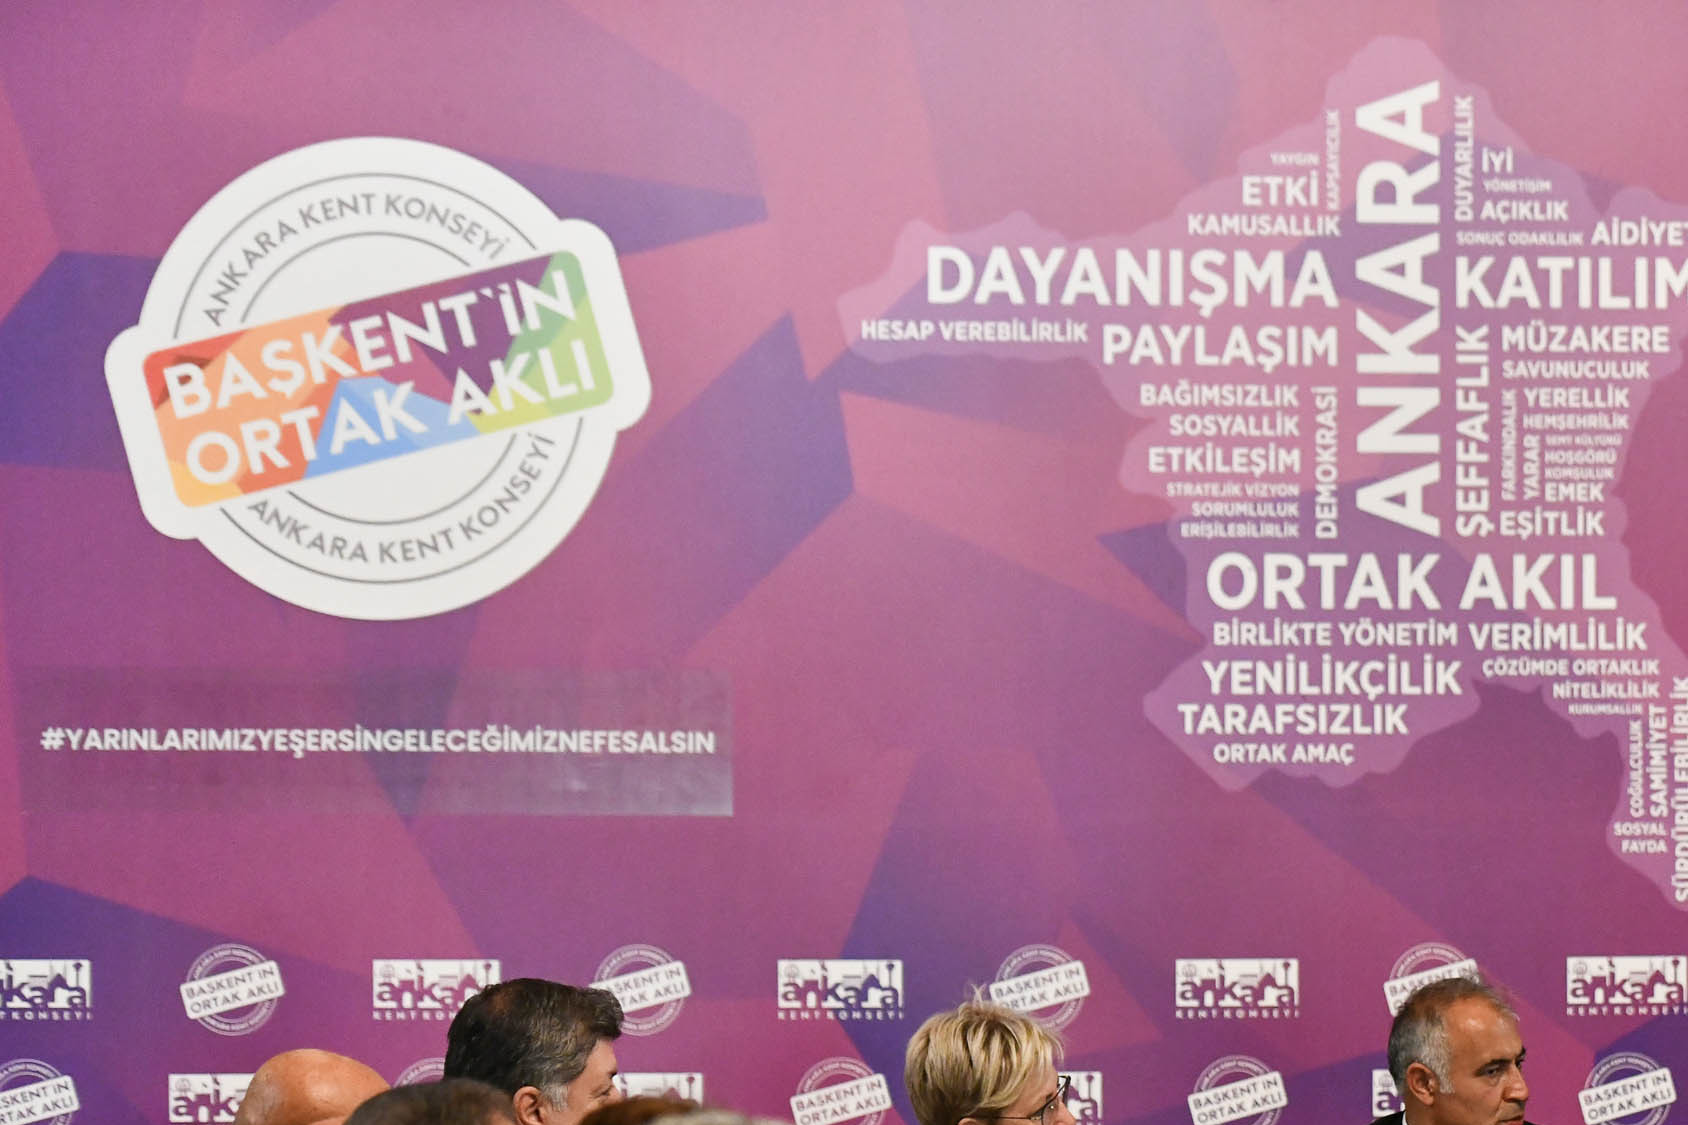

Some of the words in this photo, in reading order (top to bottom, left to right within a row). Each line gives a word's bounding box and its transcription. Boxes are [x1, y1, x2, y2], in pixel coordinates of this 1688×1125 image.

[1455, 96, 1474, 221] DUYARLILIK
[1482, 147, 1513, 173] İYİ
[1242, 170, 1319, 206] ETKİ
[1188, 213, 1341, 237] KAMUSALLIK
[1480, 200, 1569, 224] AÇIKLIK
[205, 220, 298, 326] ANKARA
[298, 192, 376, 229] KENT
[384, 194, 510, 259] KONSEYİ
[927, 245, 1339, 318] DAYANIŞMA
[1355, 79, 1440, 538] ANKARA
[861, 320, 934, 341] HESAP
[939, 316, 1088, 342] VEREBİLİRLİK
[1501, 319, 1670, 353] MÜZAKERE
[1103, 324, 1338, 373] PAYLAŞIM
[1502, 359, 1650, 379] SAVUNUCULUK
[1140, 379, 1299, 407] BAĞIMSIZLIK
[1523, 384, 1630, 408] YERELLİK
[185, 387, 428, 485] ORTAK
[447, 339, 596, 426] AKLI
[1169, 411, 1299, 437] SOSYALLİK
[1455, 324, 1495, 538] ŞEFFAFLIK
[1148, 442, 1300, 477] ETKİLEŞİM
[1312, 386, 1338, 539] DEMOKRASİ
[1523, 434, 1540, 501] YARAR
[247, 498, 368, 564] ANKARA
[378, 530, 458, 566] KENT
[459, 432, 556, 540] KONSEYİ
[1545, 482, 1604, 502] EMEK
[1192, 501, 1299, 517] SORUMLULUK
[1500, 505, 1605, 541] EŞİTLİK
[1206, 552, 1441, 611] ORTAK
[1458, 552, 1618, 611] AKIL
[1213, 617, 1331, 647] BİRLİKTE
[1339, 616, 1458, 648] YÖNETİM
[1468, 617, 1648, 650] VERİMLİLİK
[1202, 654, 1463, 700] YENİLİKÇİLİK
[1482, 656, 1568, 678] ÇÖZÜMDE
[1573, 659, 1660, 676] ORTAKLIK
[1553, 680, 1660, 699] NİTELİKLİLİK
[1177, 703, 1409, 735] TARAFSIZLIK
[40, 724, 717, 759] #YARINLARIMIZYEŞERSİNGELECEĞİMİZNEFESALSIN
[1213, 742, 1286, 764] ORTAK
[1292, 742, 1355, 766] AMAÇ
[1646, 703, 1669, 818] SAMİMİYET
[1614, 821, 1667, 836] SOSYAL
[1621, 840, 1668, 853] FAYDA
[0, 970, 91, 1009] kara
[374, 972, 482, 1009] anka
[620, 992, 649, 1006] TAK
[0, 1107, 36, 1124] RTAK
